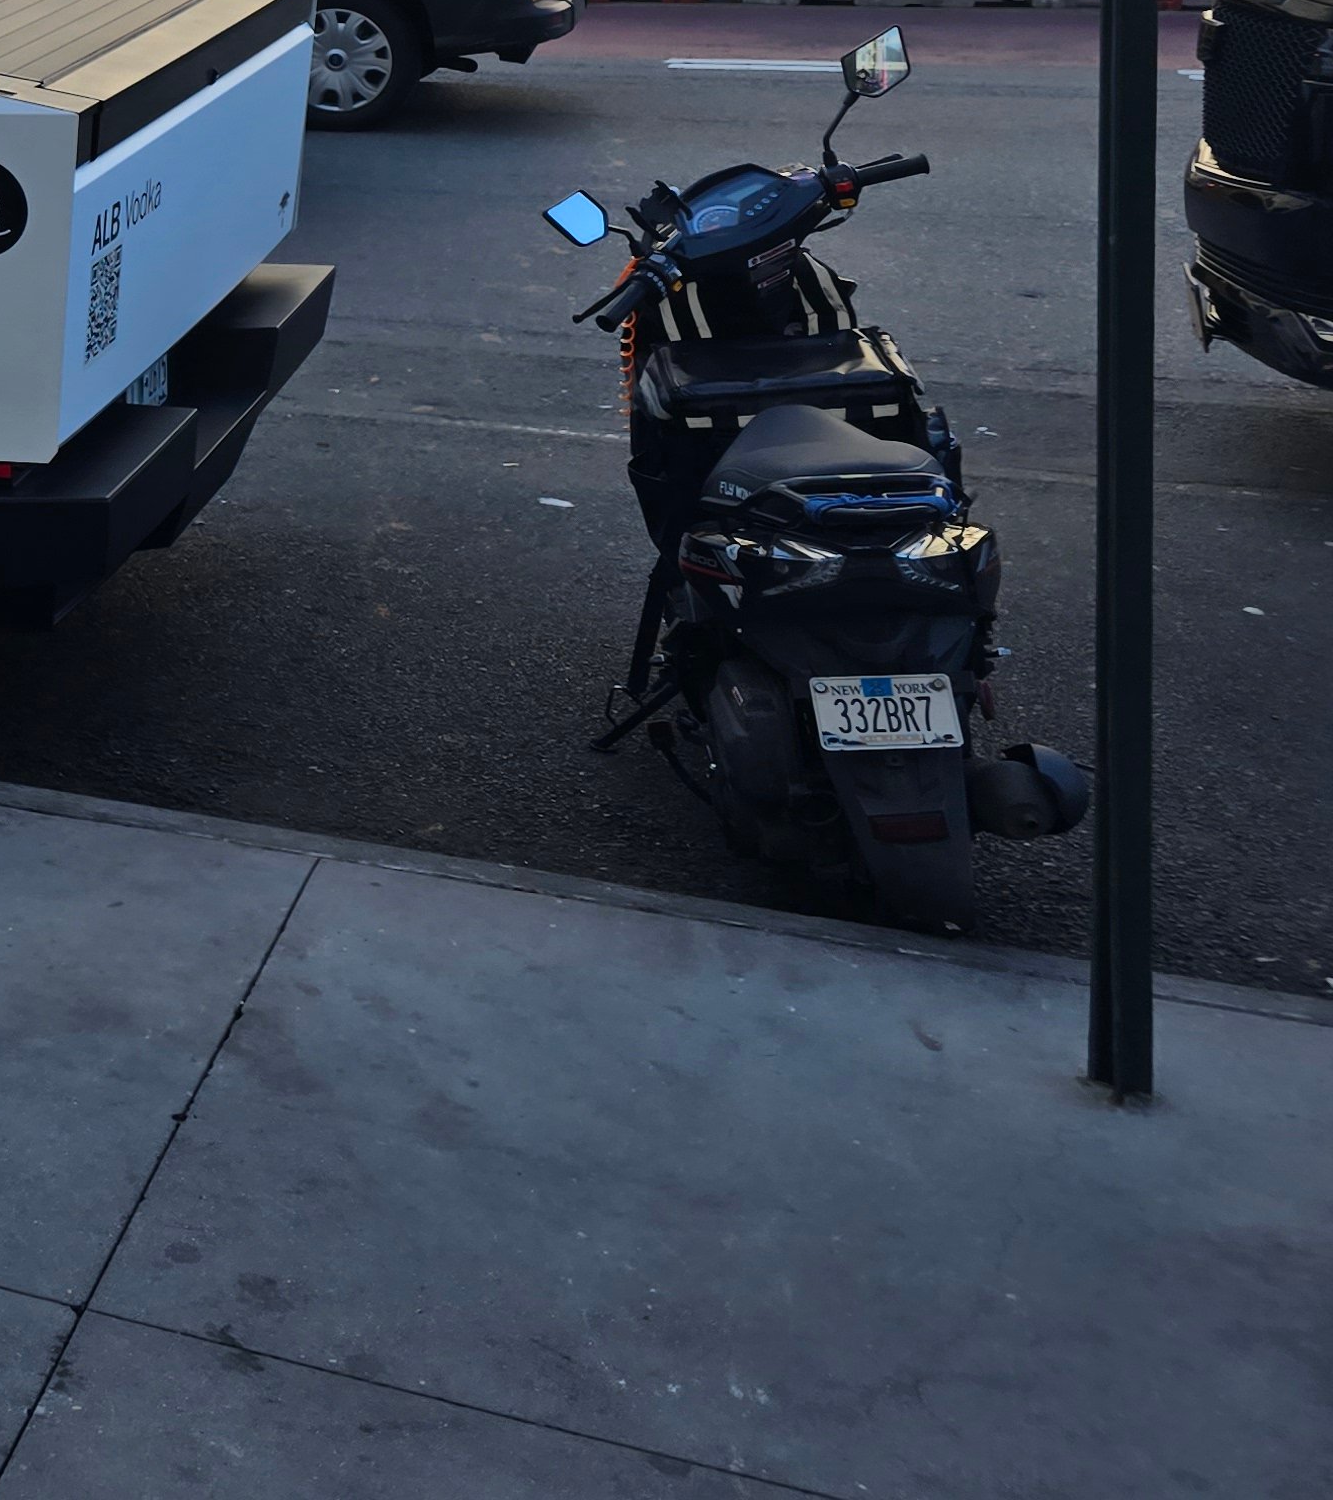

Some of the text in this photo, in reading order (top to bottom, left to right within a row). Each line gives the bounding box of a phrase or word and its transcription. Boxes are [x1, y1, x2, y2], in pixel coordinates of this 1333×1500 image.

[91, 178, 163, 257] ALB Vodka
[831, 683, 933, 696] NEW YORK
[834, 696, 932, 734] 332BR7
